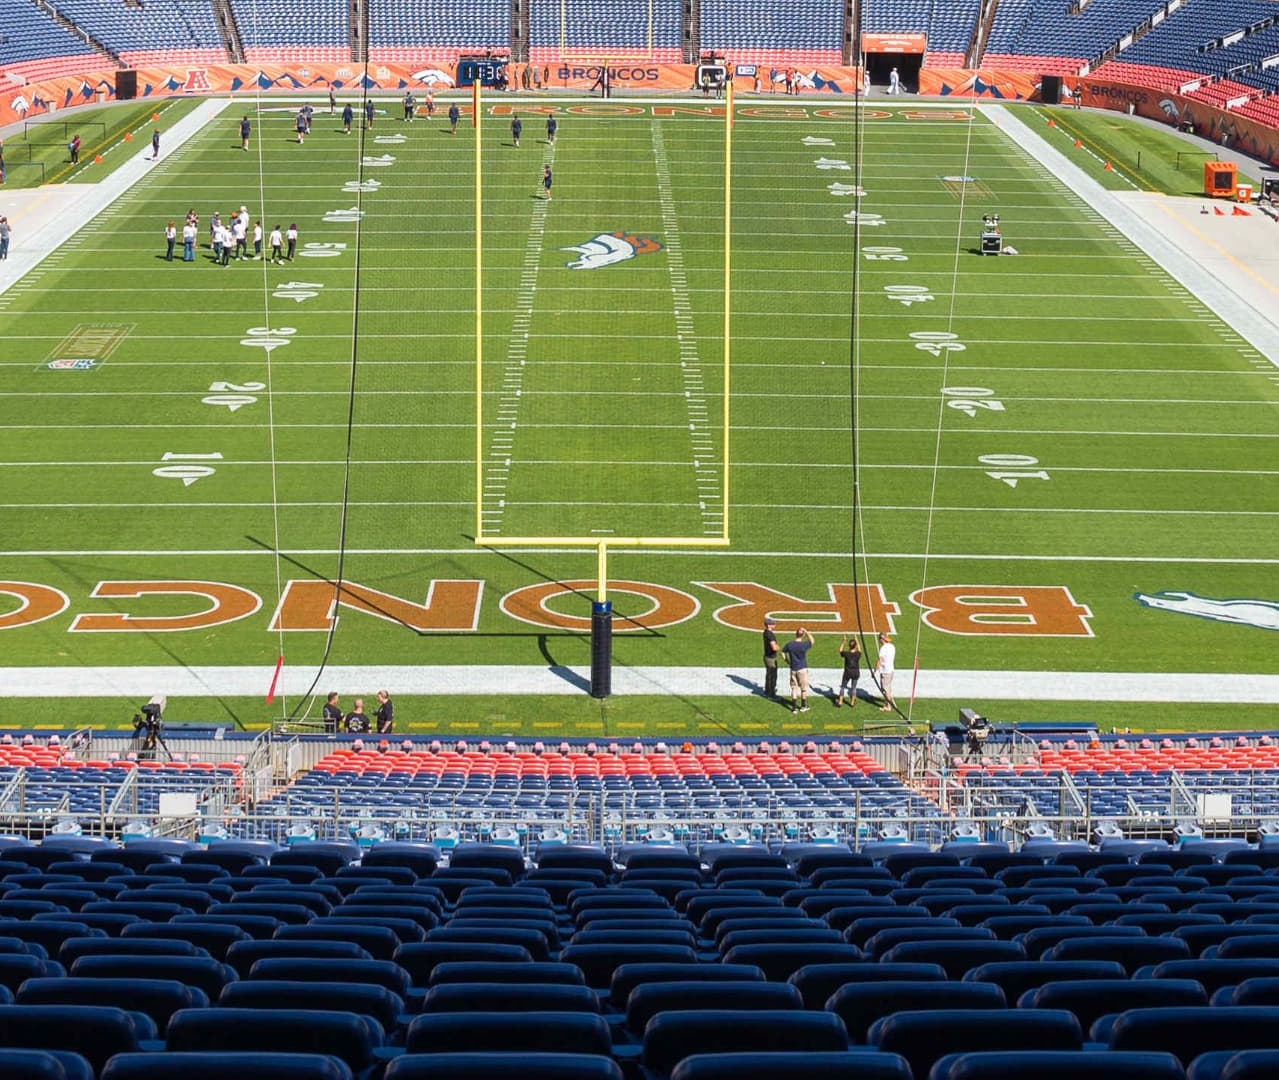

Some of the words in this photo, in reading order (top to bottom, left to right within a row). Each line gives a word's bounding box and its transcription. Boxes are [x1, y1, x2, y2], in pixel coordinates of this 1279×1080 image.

[558, 67, 659, 80] BRONCOS
[1090, 85, 1148, 105] BRONCOS
[297, 242, 347, 257] 50
[862, 246, 910, 262] 50
[272, 281, 324, 303] 40
[883, 284, 935, 306] 40
[240, 326, 297, 351] 30
[909, 331, 966, 357] 30
[201, 381, 267, 412] 20
[940, 386, 1005, 417] 20
[152, 451, 224, 486] 10
[977, 453, 1051, 488] 10
